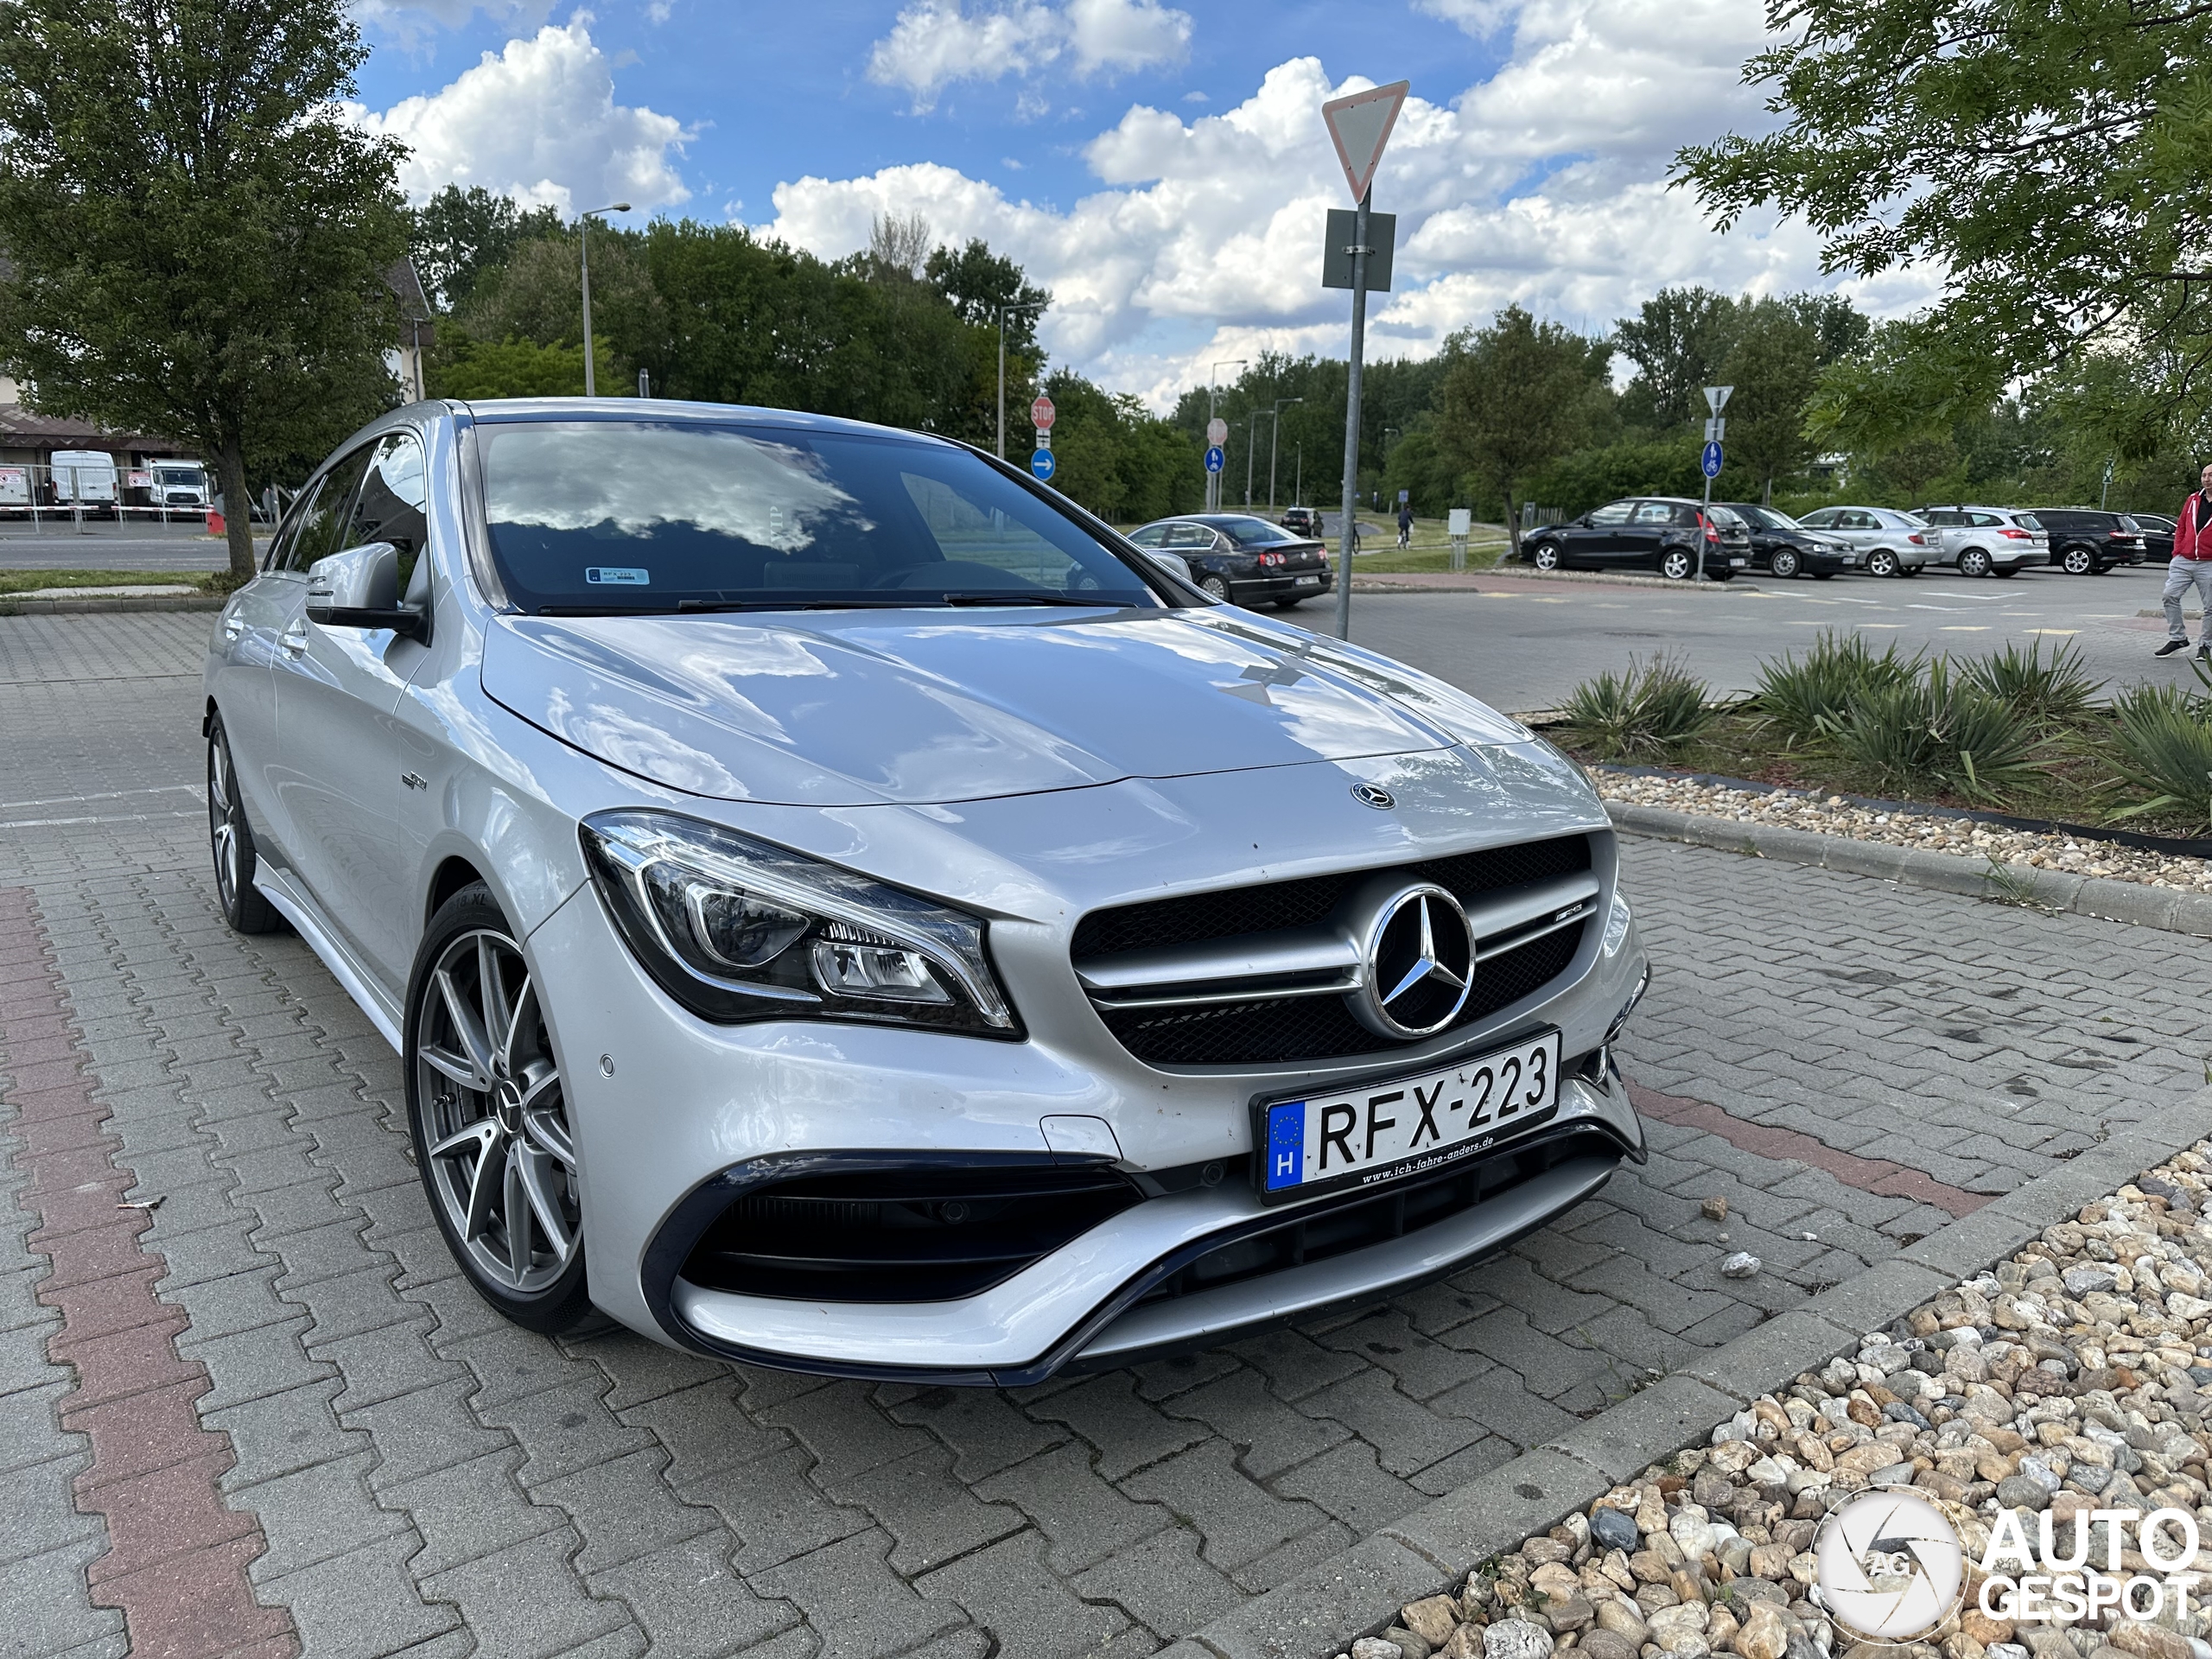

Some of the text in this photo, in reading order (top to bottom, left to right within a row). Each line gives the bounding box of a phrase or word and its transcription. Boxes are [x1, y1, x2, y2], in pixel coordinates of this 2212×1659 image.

[1033, 406, 1054, 421] STOP
[472, 893, 486, 906] XL
[1319, 1046, 1547, 1170] RFX-223
[1277, 1152, 1293, 1176] H
[1363, 1136, 1493, 1184] www.ich-fahre-anders.de
